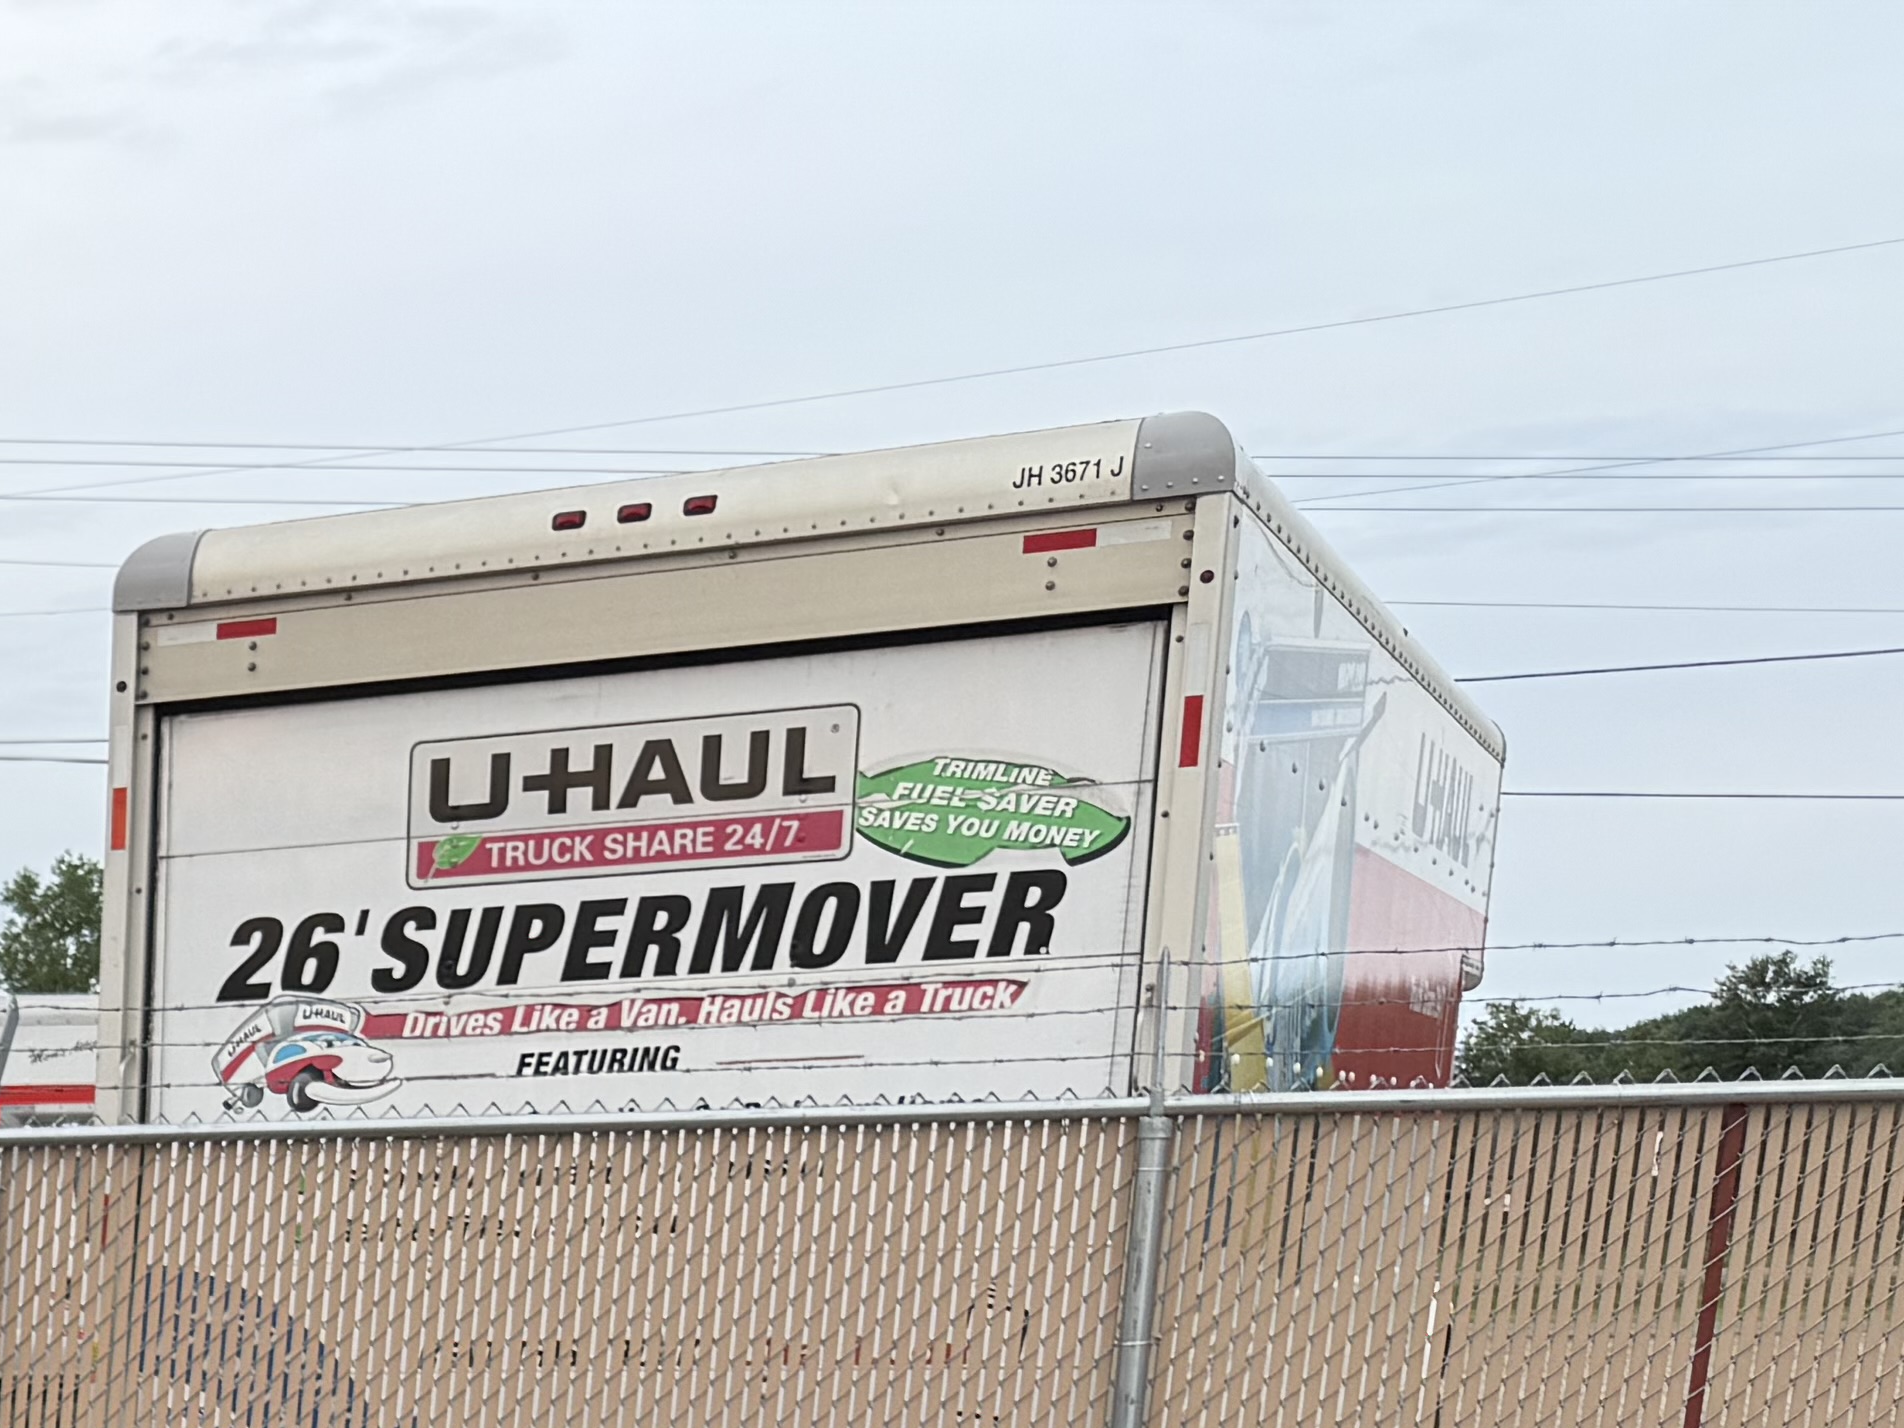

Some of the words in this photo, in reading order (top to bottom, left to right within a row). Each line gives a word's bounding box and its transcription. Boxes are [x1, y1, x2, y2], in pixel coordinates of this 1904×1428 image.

[1012, 465, 1043, 489] JH
[1050, 458, 1102, 484] 3671
[1110, 455, 1124, 477] J
[428, 726, 837, 824] U-HAUL
[933, 757, 1055, 787] TRIMLINE
[891, 781, 968, 808] FUEL
[976, 788, 1079, 818] SAVER
[484, 834, 594, 869] TRUCK
[602, 824, 715, 860] SHARE
[724, 819, 800, 851] 24/7
[857, 807, 939, 833] SAVES
[945, 814, 1001, 838] YOU
[1002, 820, 1101, 848] MONEY
[372, 869, 1068, 994] SUPERMOVER
[401, 1009, 502, 1039] Drives
[510, 1004, 579, 1033] Like
[586, 1006, 607, 1029] a
[619, 998, 688, 1028] Van.
[697, 993, 794, 1024] Hauls
[800, 989, 874, 1018] Like
[882, 991, 904, 1014] a
[918, 981, 1017, 1013] Truck
[515, 1045, 681, 1077] FEATURING
